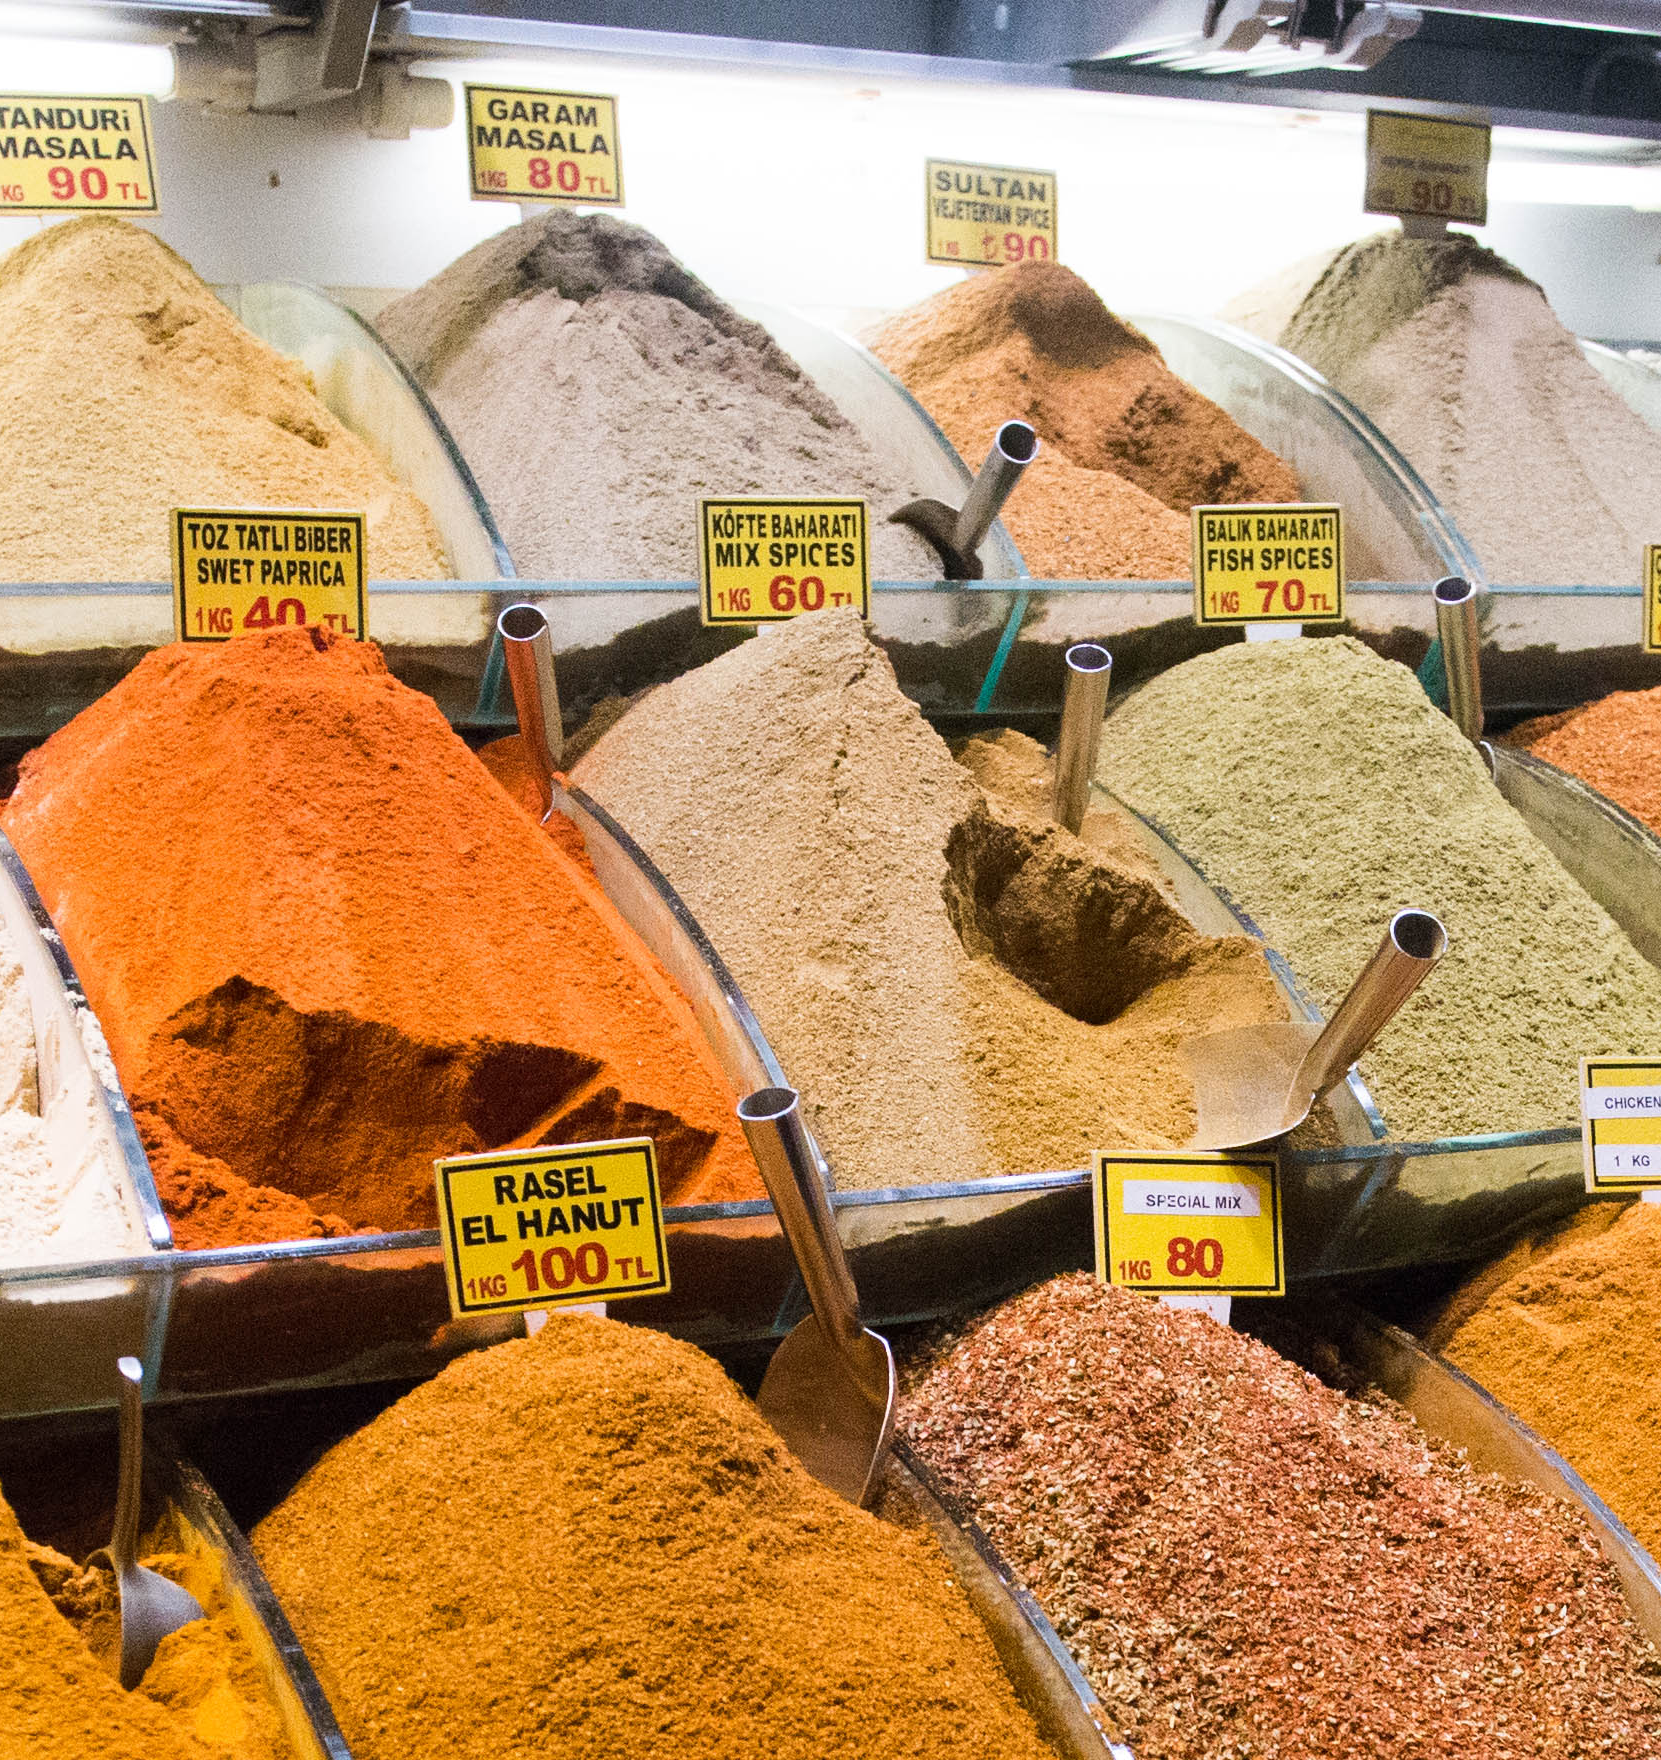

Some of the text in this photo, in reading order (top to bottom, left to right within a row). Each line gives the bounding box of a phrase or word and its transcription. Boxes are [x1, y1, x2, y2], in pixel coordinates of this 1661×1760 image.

[488, 98, 598, 128] GARAM
[476, 125, 610, 155] MASALA
[48, 166, 148, 201] 90 TL
[528, 156, 612, 195] 80 TL
[935, 169, 1047, 202] SULTAN
[1412, 180, 1452, 211] 90
[1014, 205, 1051, 231] SPICE
[1003, 231, 1050, 262] 90
[187, 521, 232, 552] TOZ
[234, 523, 290, 554] TATLI
[769, 513, 857, 540] BAHARATI
[1206, 517, 1334, 543] BALIK BAHARATI
[715, 542, 855, 568] MIX SPICES
[1207, 546, 1334, 572] FISH SPICES
[196, 559, 347, 588] SWET PAPRICA
[768, 574, 825, 612] 60
[1255, 578, 1333, 613] 70 TL
[242, 595, 307, 629] 40
[1604, 1095, 1661, 1111] CHICKEN
[1632, 1154, 1651, 1168] KG
[492, 1165, 608, 1206] RASEL
[1145, 1193, 1211, 1210] SPECIAL
[461, 1196, 646, 1249] EL HANUT
[510, 1240, 610, 1293] 100
[614, 1255, 653, 1283] TL
[1166, 1236, 1224, 1280] 80
